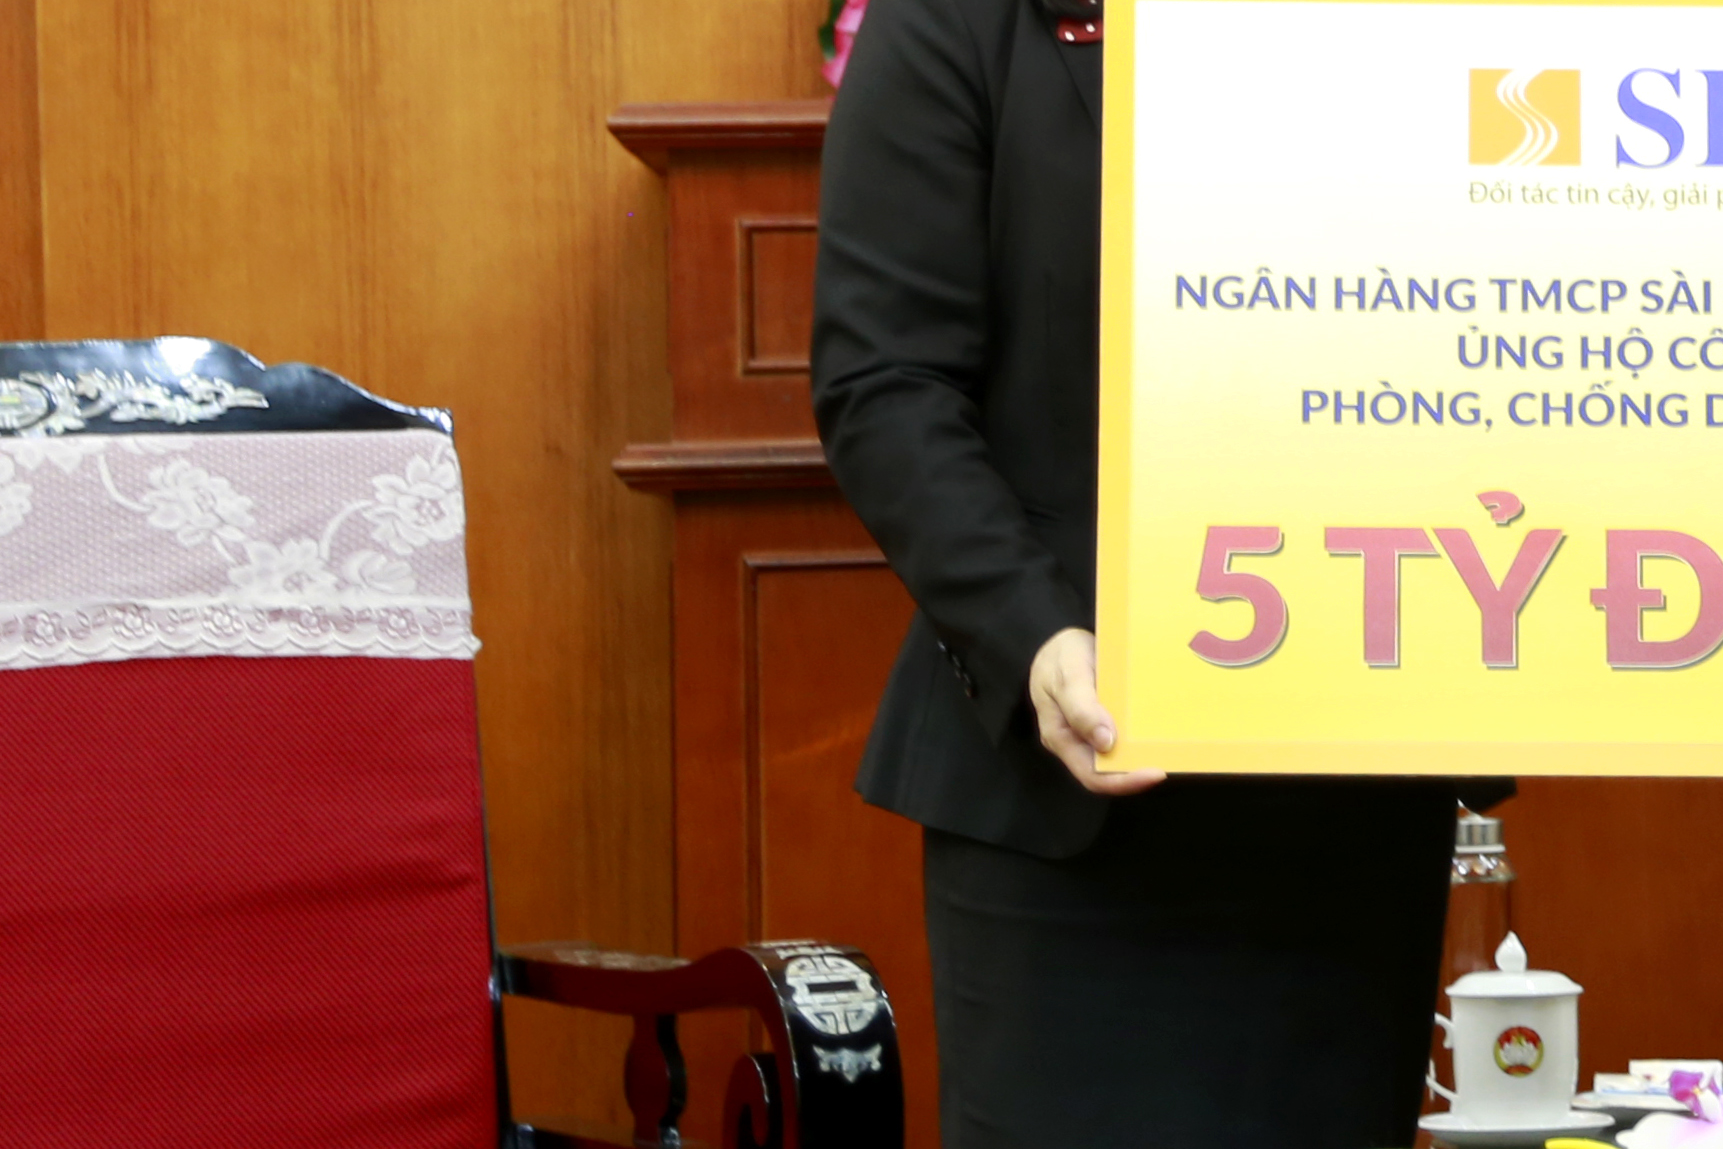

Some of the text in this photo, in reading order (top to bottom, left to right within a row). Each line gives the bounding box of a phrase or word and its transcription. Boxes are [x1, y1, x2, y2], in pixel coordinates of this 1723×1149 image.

[1469, 179, 1511, 206] Đối
[1521, 183, 1558, 207] tác
[1566, 183, 1600, 206] tin
[1607, 183, 1654, 210] cậy,
[1663, 183, 1708, 210] giải
[1174, 267, 1317, 311] NGÂN
[1334, 267, 1477, 312] HÀNG
[1489, 279, 1628, 313] TMCP
[1640, 270, 1712, 315] SÀI
[1580, 328, 1654, 379] HỘ
[1301, 381, 1494, 432] PHÒNG,
[1507, 381, 1690, 427] CHỐNG
[1188, 525, 1286, 666] 5
[1324, 490, 1566, 668] TỶ
